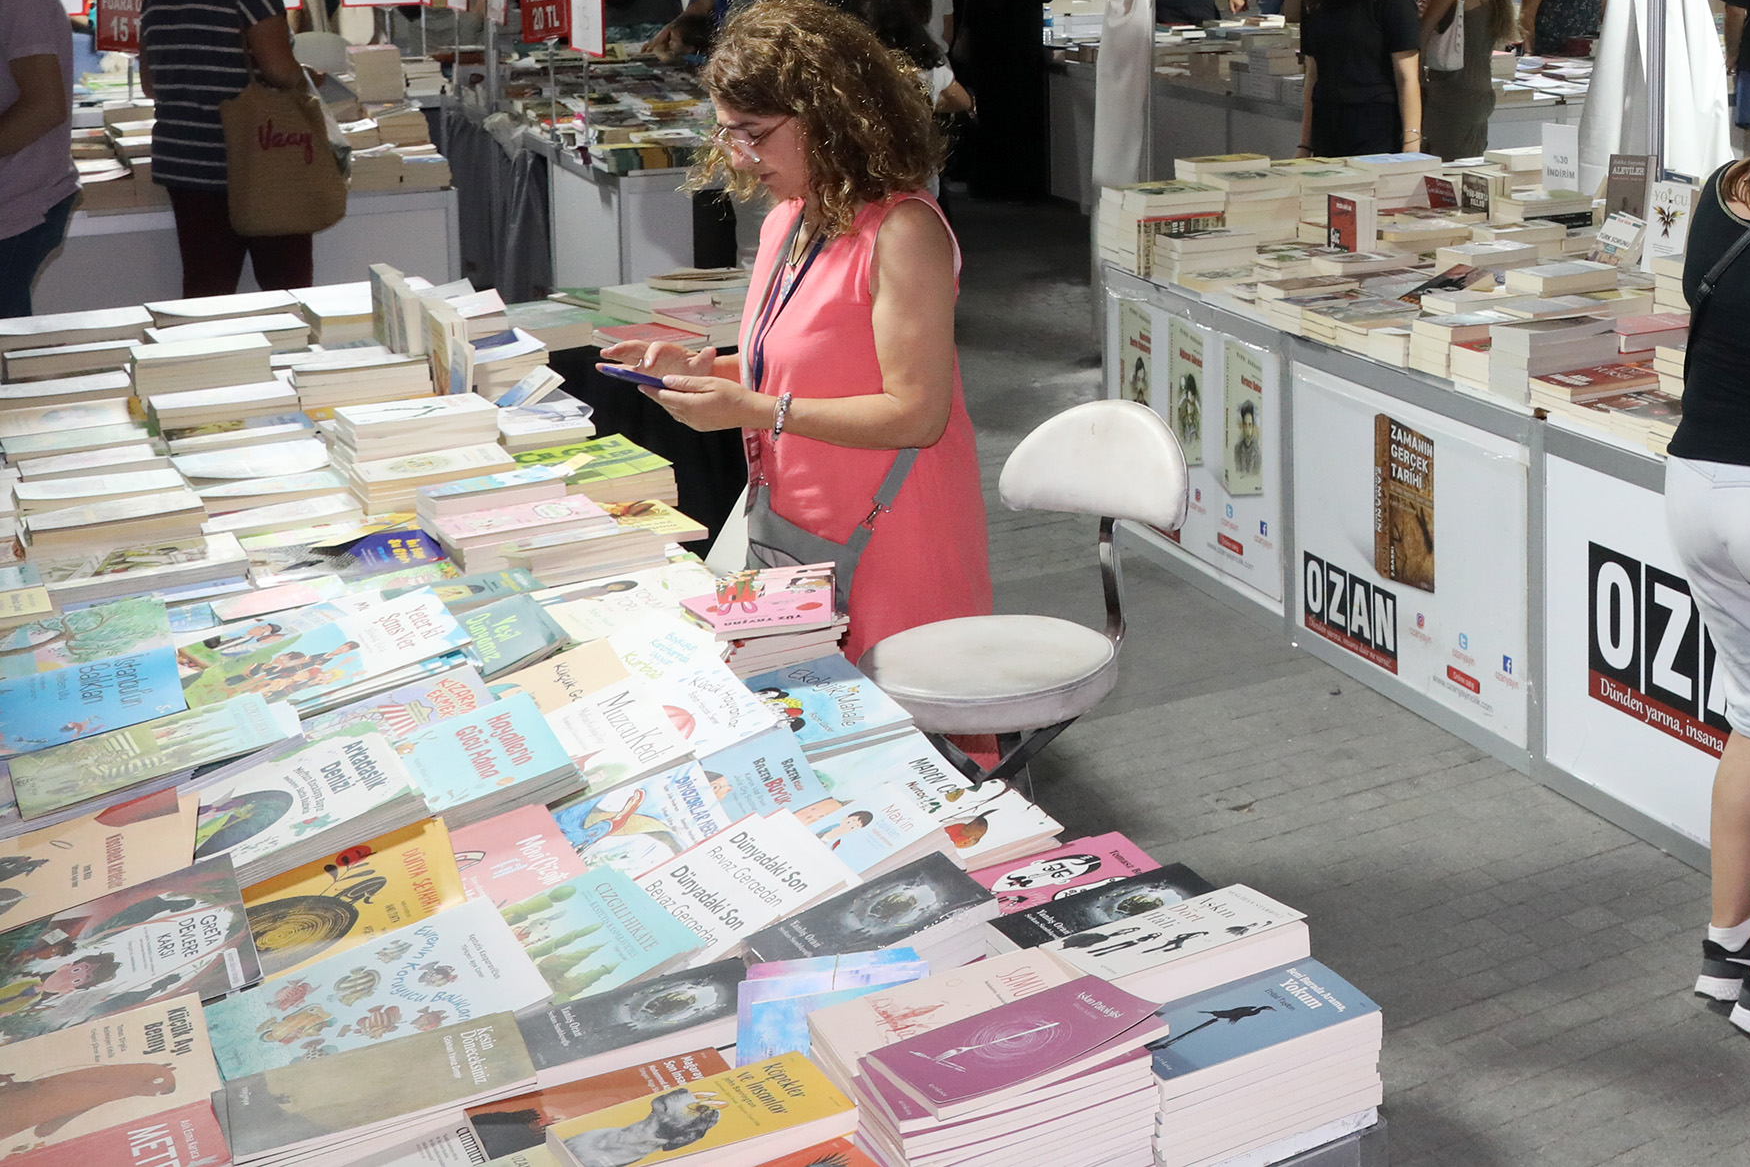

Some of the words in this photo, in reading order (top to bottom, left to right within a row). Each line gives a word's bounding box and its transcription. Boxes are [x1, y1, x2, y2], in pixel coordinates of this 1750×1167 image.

[111, 17, 128, 41] 15
[533, 7, 544, 30] 20
[545, 5, 560, 28] TL
[1546, 166, 1576, 180] İNDİRİM
[1553, 154, 1569, 166] %30
[1612, 165, 1645, 176] ALEVİLER
[1391, 425, 1433, 458] ZAMANIN
[1391, 445, 1429, 474] GERÇEK
[1391, 463, 1422, 489] TARİHİ
[405, 604, 431, 631] Yeter
[422, 625, 445, 640] ki
[1306, 560, 1395, 652] OZAN
[374, 612, 401, 636] Şans
[397, 633, 415, 650] Ver
[553, 661, 576, 691] Küçük
[689, 676, 721, 694] Küçük
[788, 667, 843, 696] Ekolojik
[426, 689, 456, 720] EKMEK
[1433, 675, 1494, 714] www.ozanyayincilik.com
[1600, 677, 1644, 713] Dünden
[1645, 701, 1684, 737] yarına,
[1685, 718, 1724, 752] insana
[455, 725, 485, 751] Gücü
[486, 712, 535, 767] Hayallerin
[627, 723, 674, 766] Kedi
[320, 760, 354, 795] Denizi
[342, 740, 388, 791] Arkadaşlık
[468, 748, 500, 780] Adına
[781, 758, 801, 782] BAZEN
[909, 757, 941, 784] MADEN
[753, 757, 773, 783] BAZEN
[764, 777, 792, 805] BÜYÜK
[675, 775, 711, 822] DİNOZORLAR
[729, 831, 788, 877] Dünyadaki
[781, 870, 808, 893] Son
[670, 865, 727, 915] Dünyadaki
[719, 908, 745, 931] Son
[1167, 902, 1204, 925] Dört
[1197, 897, 1236, 920] Aşkın
[178, 917, 199, 958] DEVLERE
[200, 914, 221, 946] GRETA
[414, 925, 439, 959] Evrenin
[1279, 977, 1325, 1011] Yokum
[1286, 967, 1301, 982] Beni
[1297, 974, 1320, 997] Burada
[1318, 991, 1347, 1014] Arama,
[143, 1021, 166, 1055] Benny
[167, 1006, 194, 1039] Küçük
[476, 1025, 494, 1051] Kesin
[170, 1037, 194, 1056] Ayı
[460, 1029, 491, 1084] Döneceksiniz
[663, 1060, 676, 1072] Son
[762, 1061, 806, 1098] Köpekler
[737, 1071, 750, 1082] ve
[748, 1078, 788, 1114] İnsanlar
